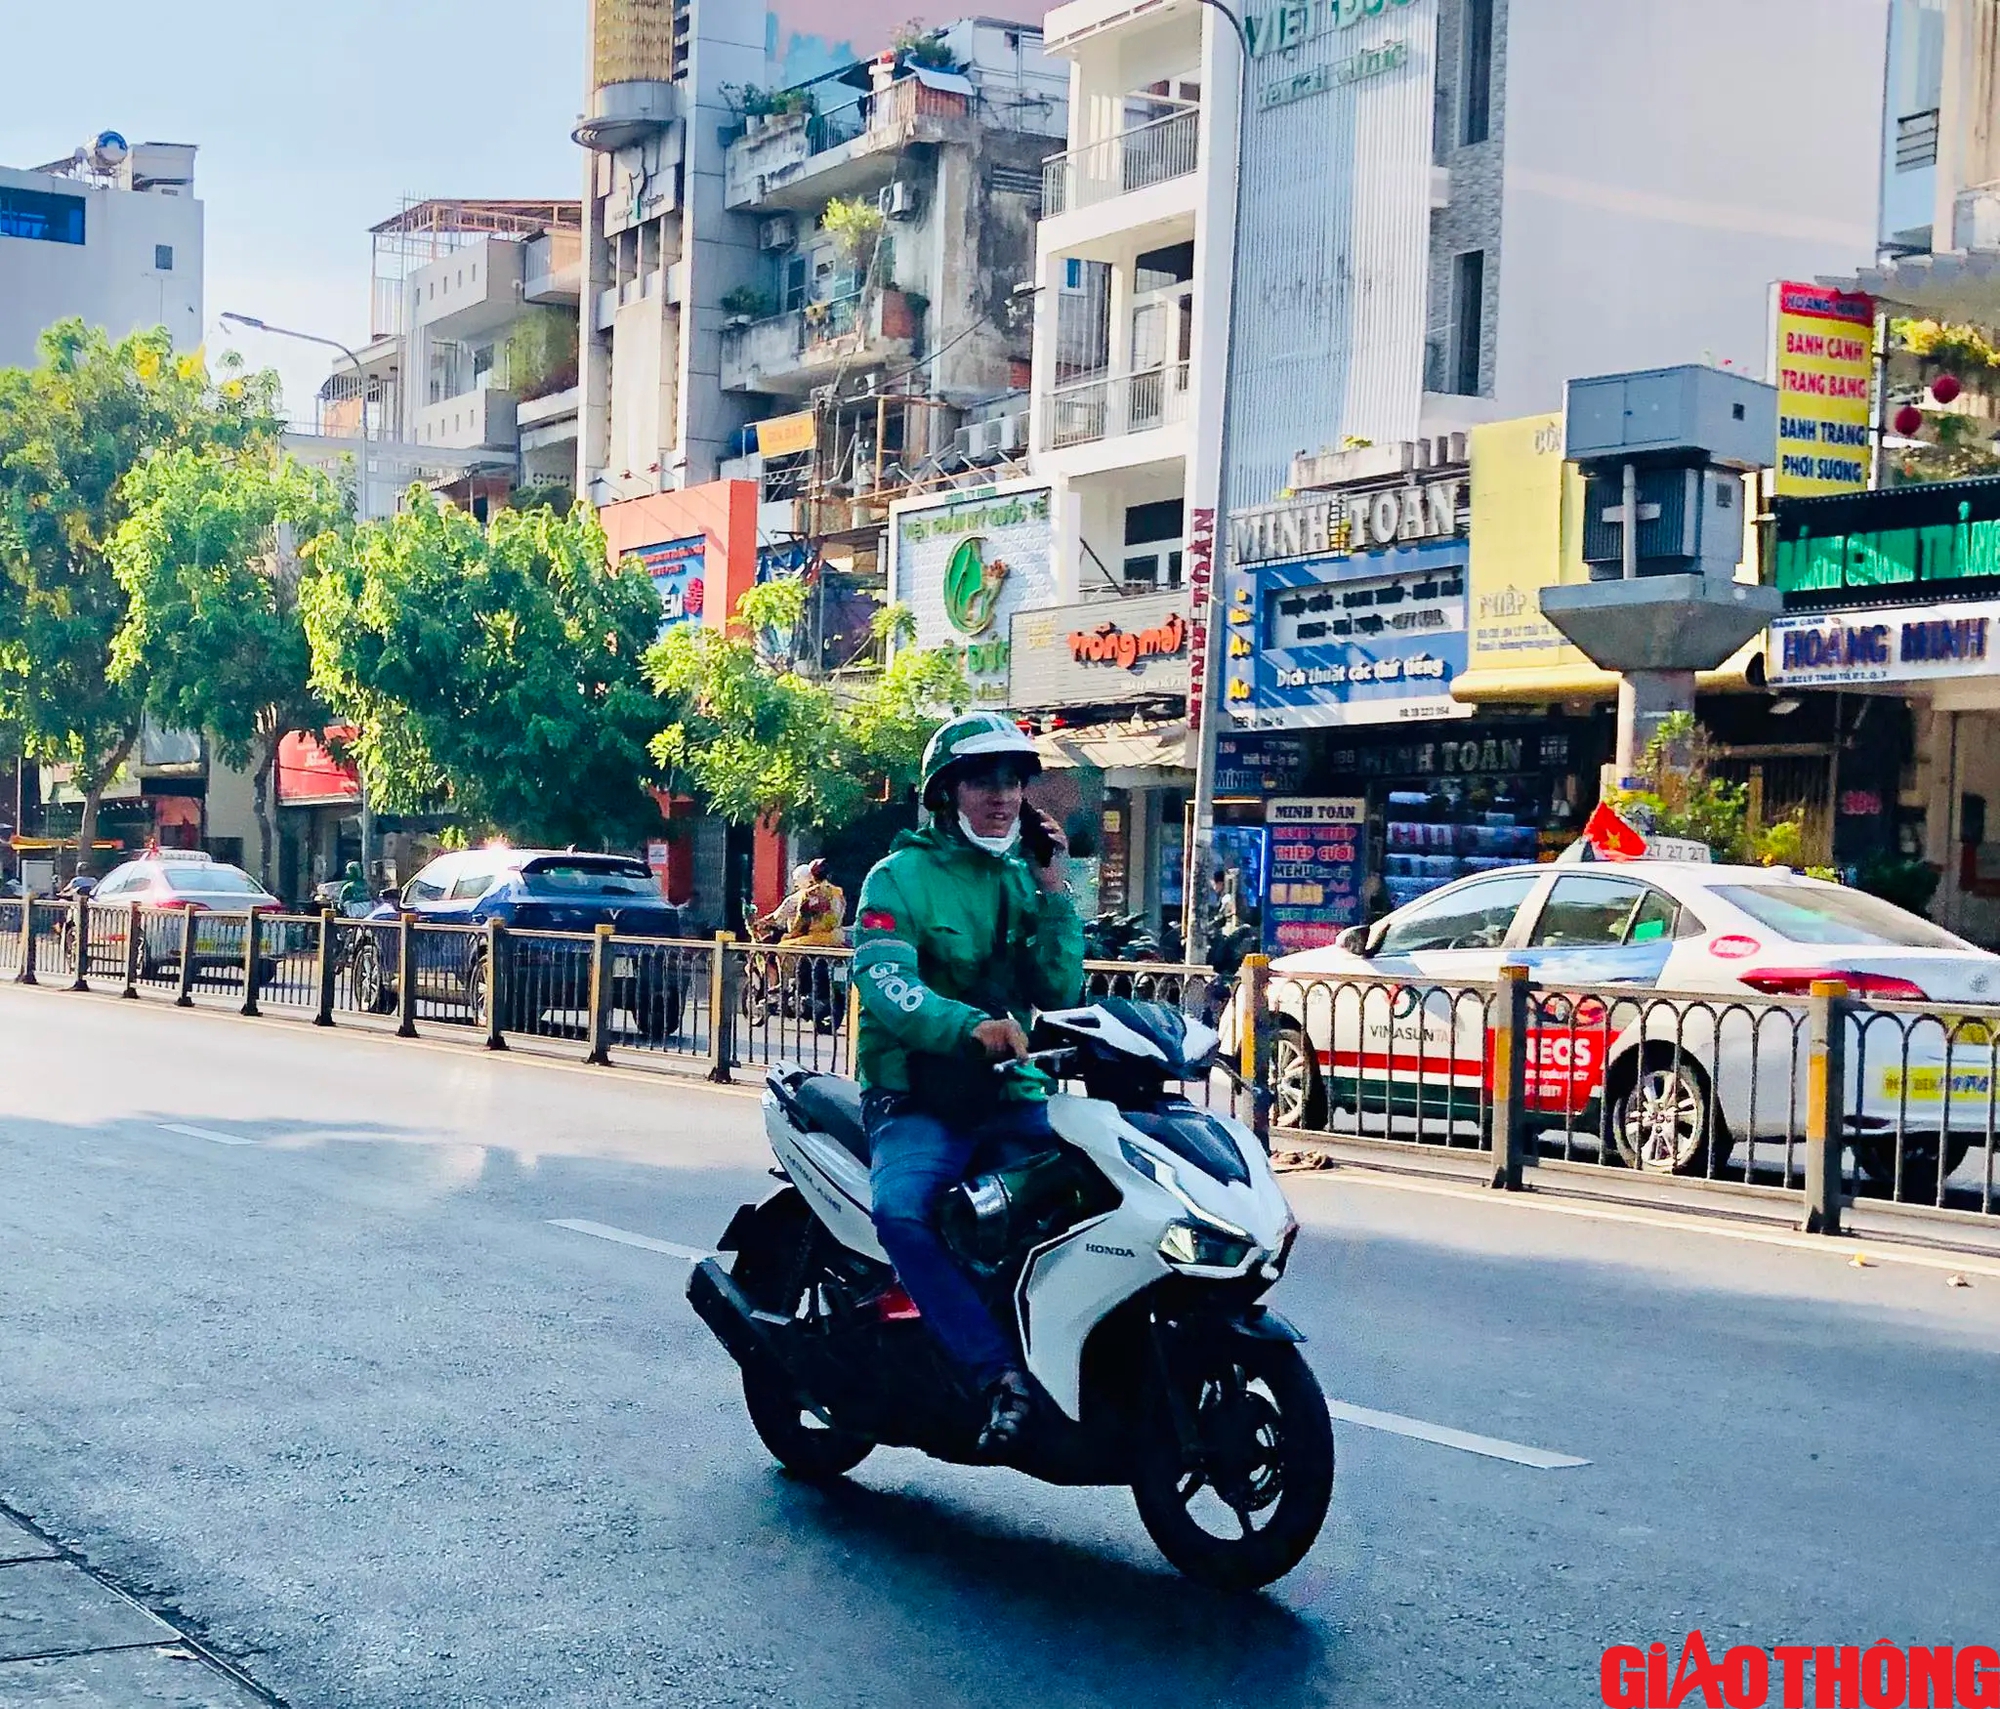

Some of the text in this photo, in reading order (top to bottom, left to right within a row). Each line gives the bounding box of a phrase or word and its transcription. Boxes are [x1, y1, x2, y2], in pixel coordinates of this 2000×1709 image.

[1231, 503, 1330, 563] MINH
[1276, 668, 1306, 690] Dịch
[1308, 664, 1346, 686] thuật
[1348, 660, 1373, 681] các
[1403, 653, 1445, 679] tiếng
[1275, 805, 1313, 819] MINH
[1666, 845, 1684, 860] 27
[1688, 846, 1706, 861] 27
[1272, 863, 1312, 880] MENU
[1085, 1243, 1135, 1258] HONDA
